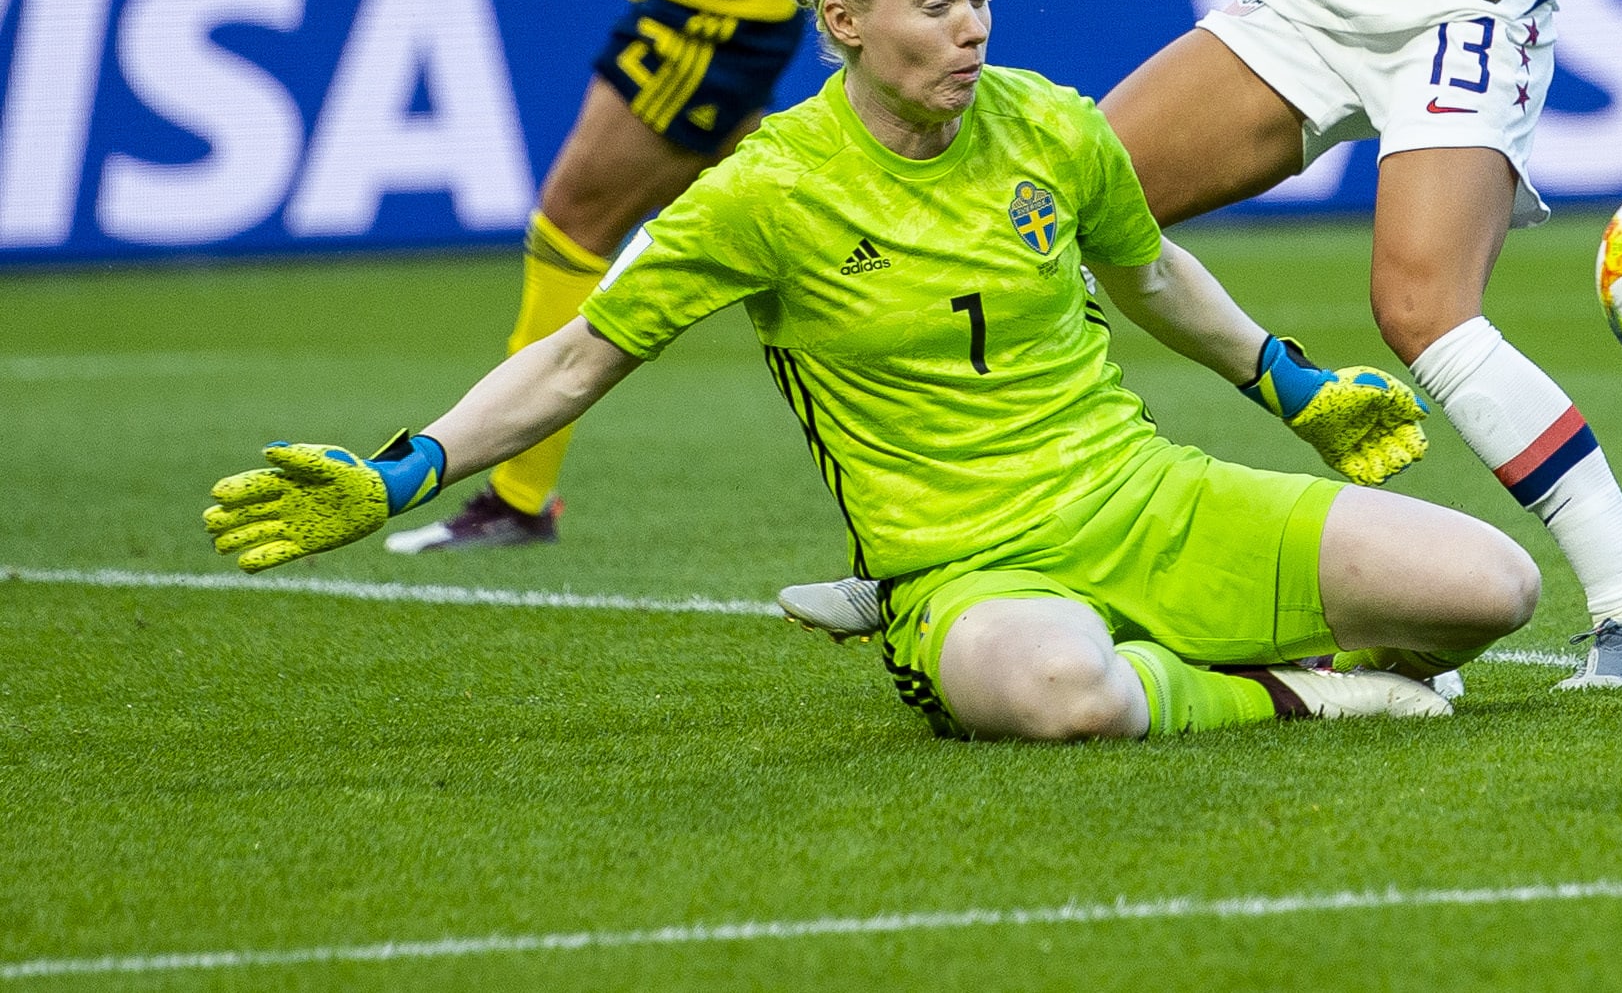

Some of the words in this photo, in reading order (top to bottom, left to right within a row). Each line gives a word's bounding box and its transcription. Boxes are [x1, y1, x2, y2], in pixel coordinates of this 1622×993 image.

[1429, 15, 1496, 95] 13
[839, 257, 892, 277] adidas
[949, 291, 992, 376] 1
